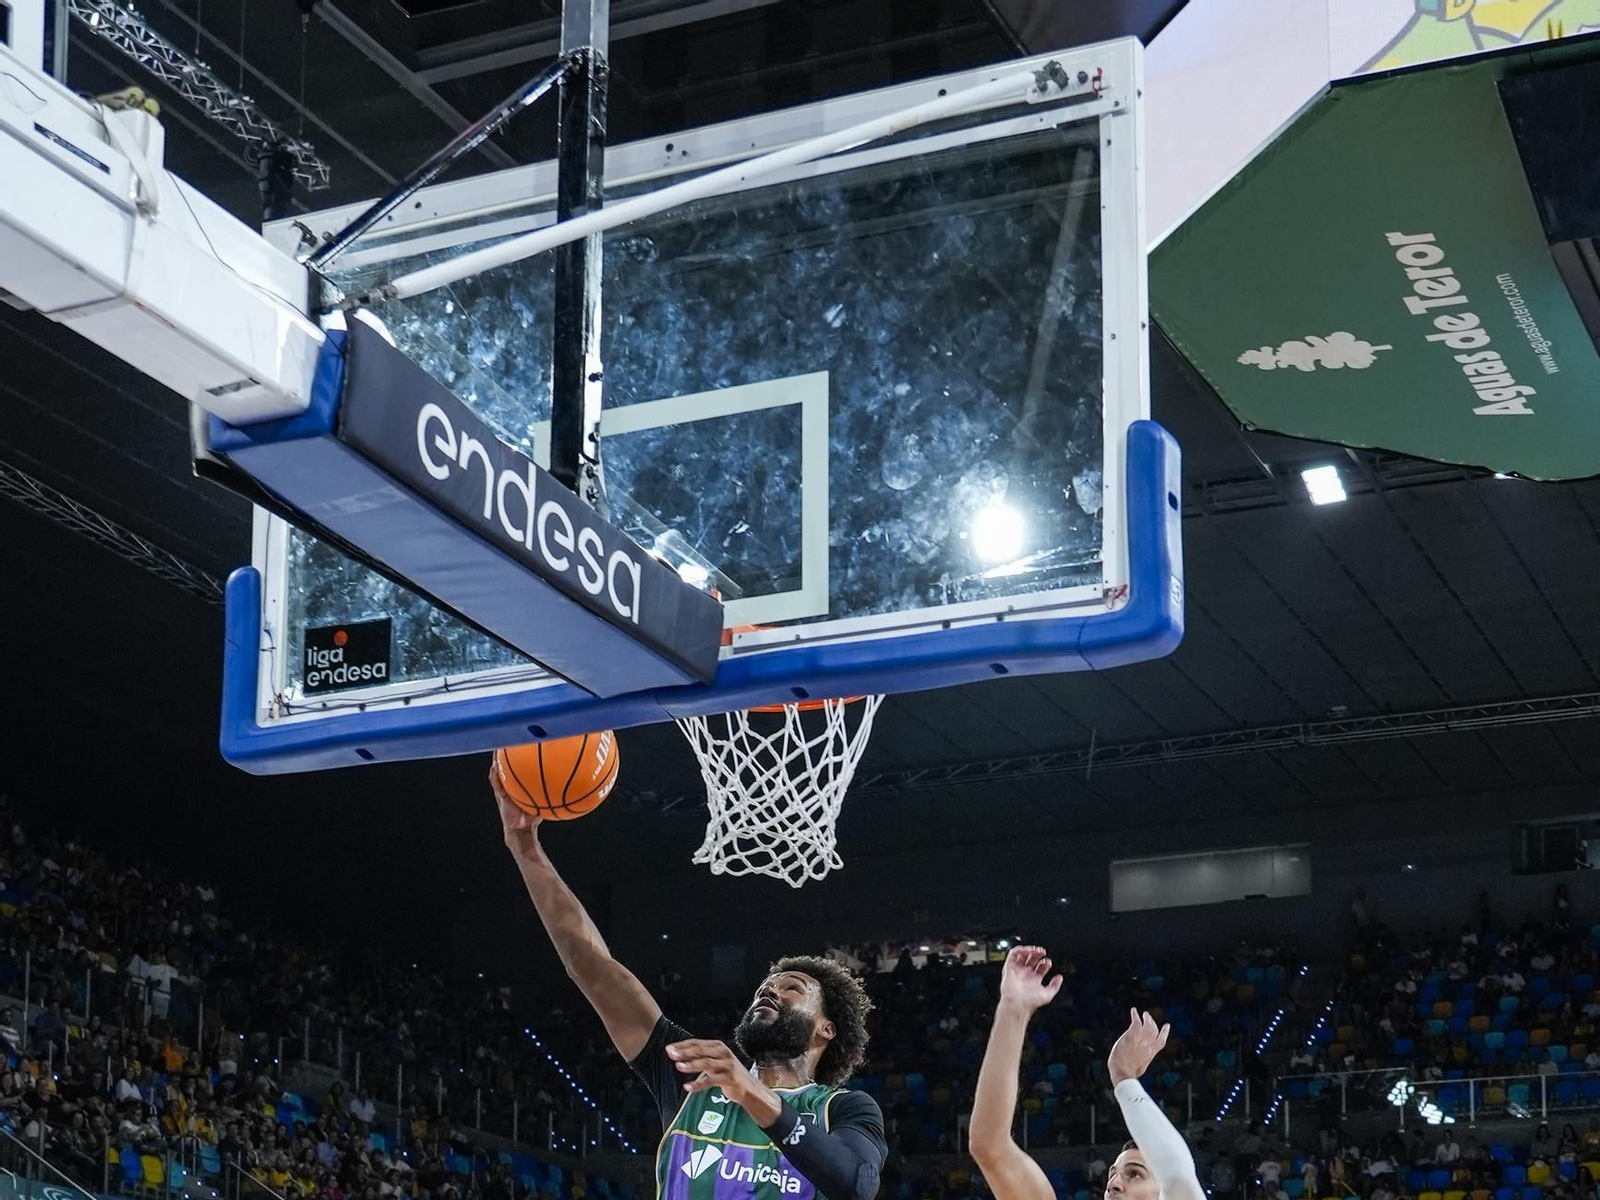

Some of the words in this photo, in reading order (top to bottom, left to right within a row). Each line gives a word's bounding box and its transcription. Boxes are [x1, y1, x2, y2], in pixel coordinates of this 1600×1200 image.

[1385, 231, 1469, 315] Teror
[1425, 312, 1491, 349] de
[1495, 272, 1560, 375] www.aguasdeteror.com
[1453, 350, 1537, 416] Aguas
[416, 402, 642, 625] endesa
[306, 646, 344, 668] liga
[306, 662, 387, 687] endesa
[720, 1158, 801, 1194] Unicaja
